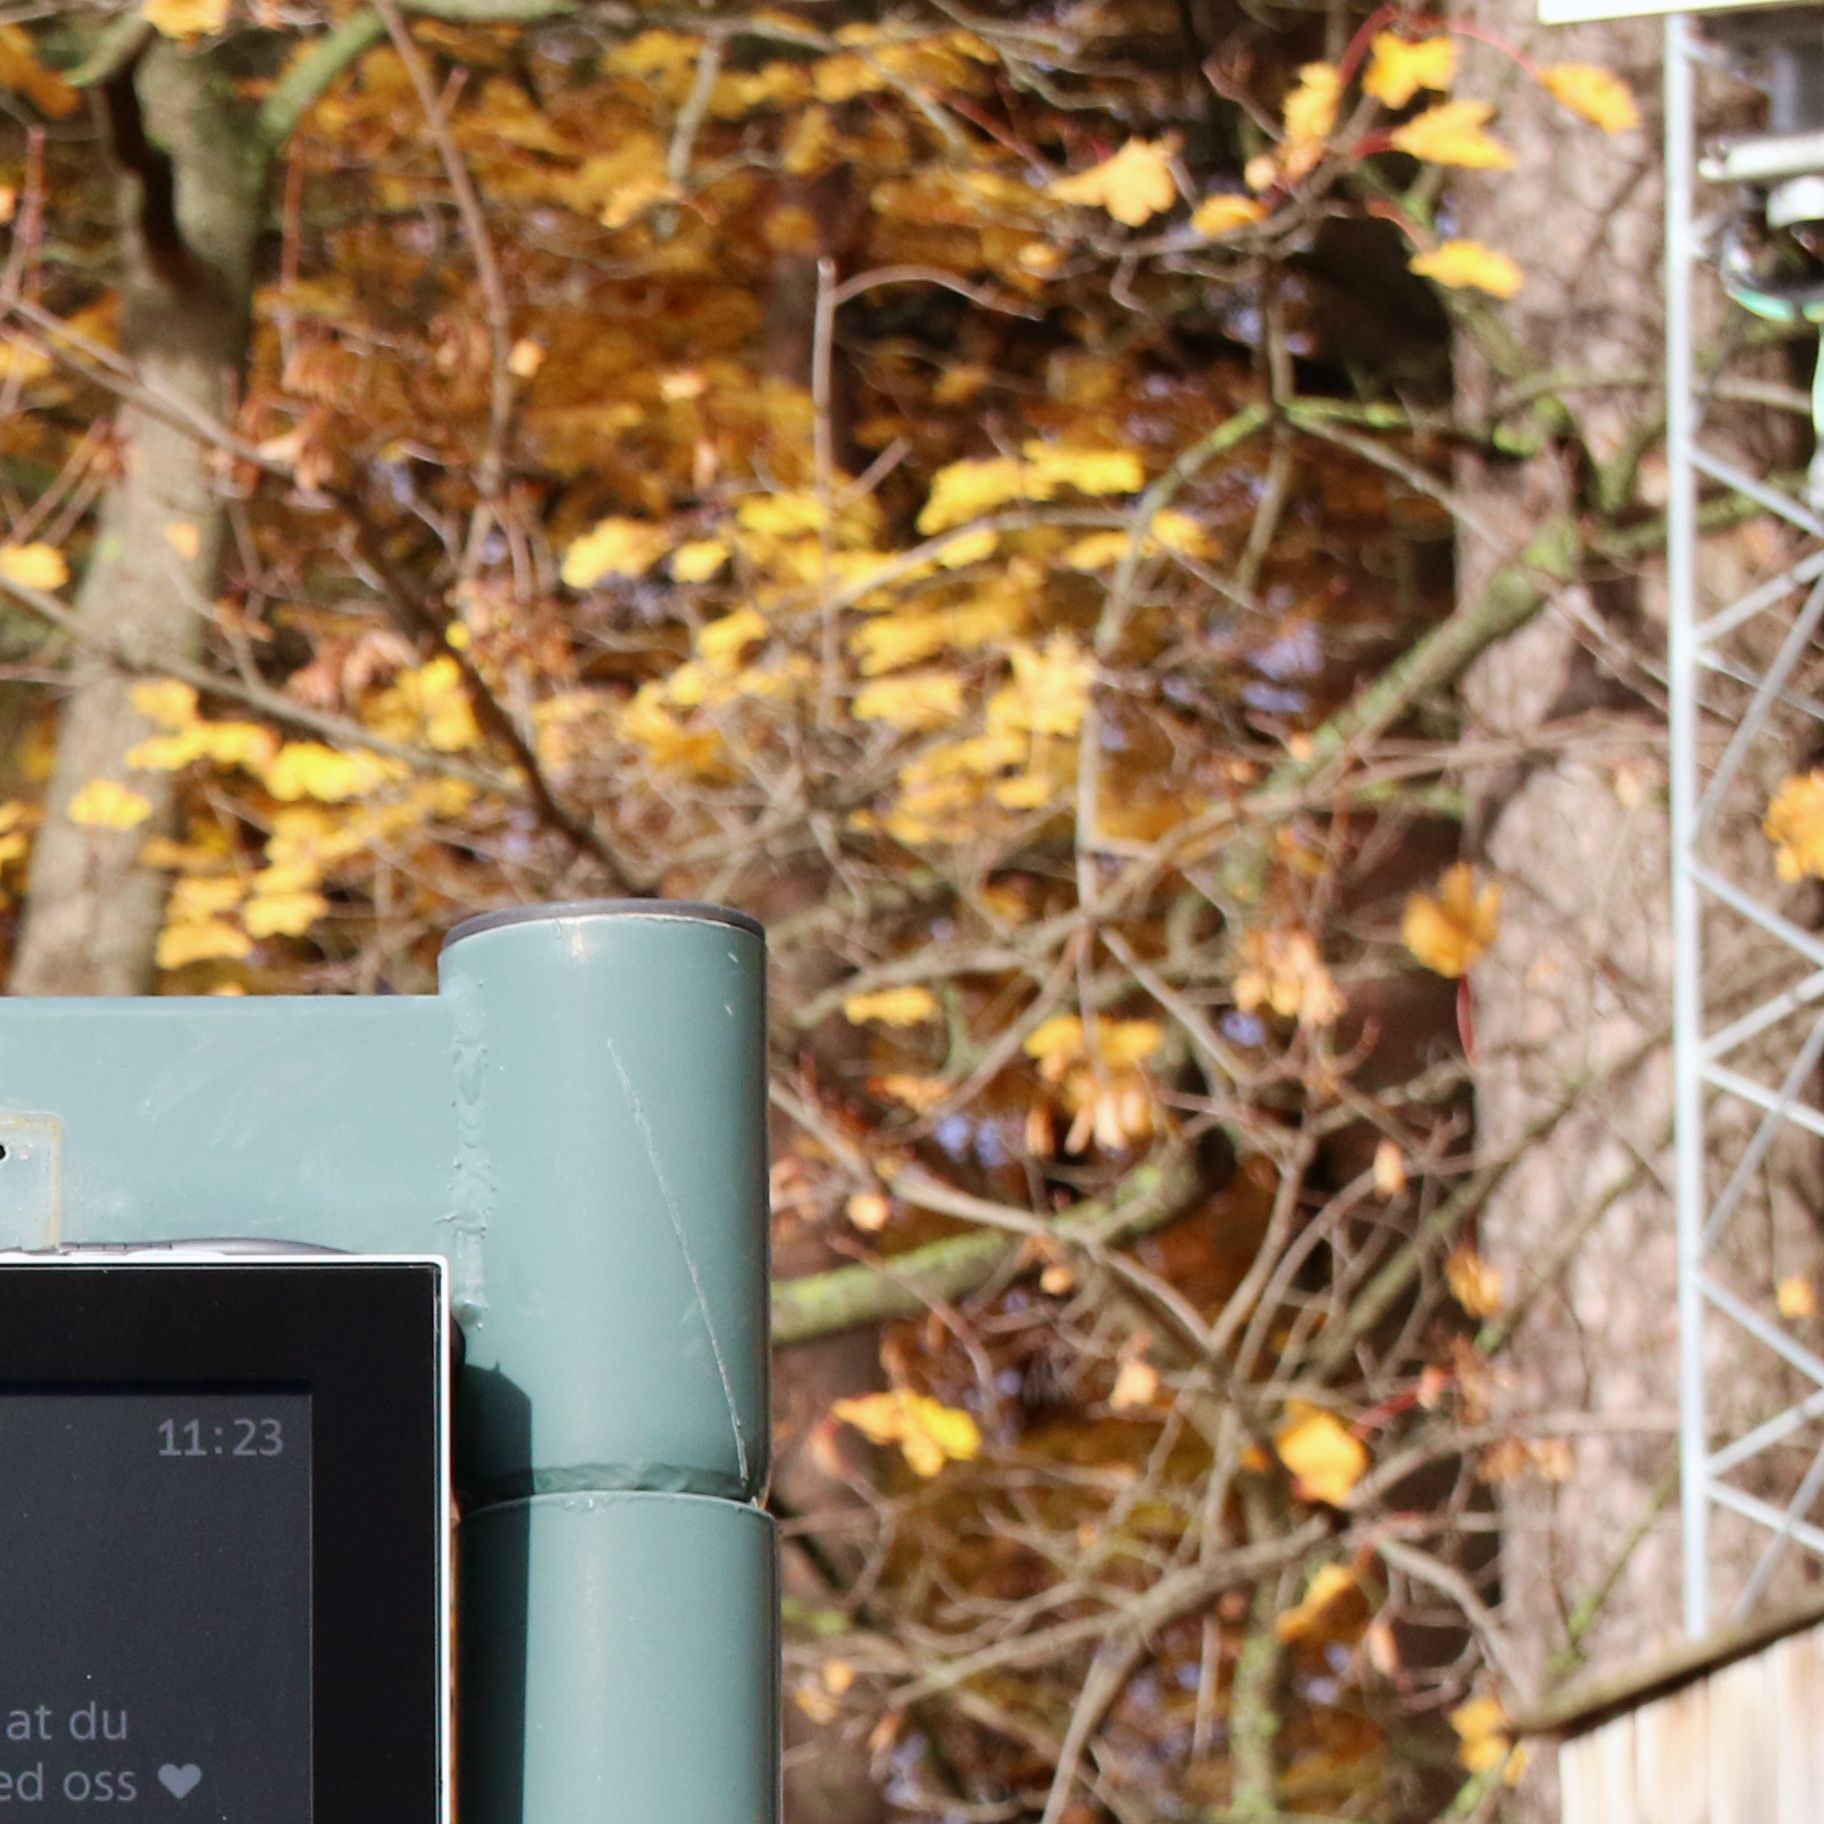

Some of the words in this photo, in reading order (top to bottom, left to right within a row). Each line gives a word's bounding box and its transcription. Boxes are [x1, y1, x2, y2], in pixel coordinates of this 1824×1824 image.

[157, 1419, 284, 1456] 11:23
[6, 1705, 53, 1742] at
[70, 1699, 128, 1742] du
[62, 1770, 138, 1802] oss
